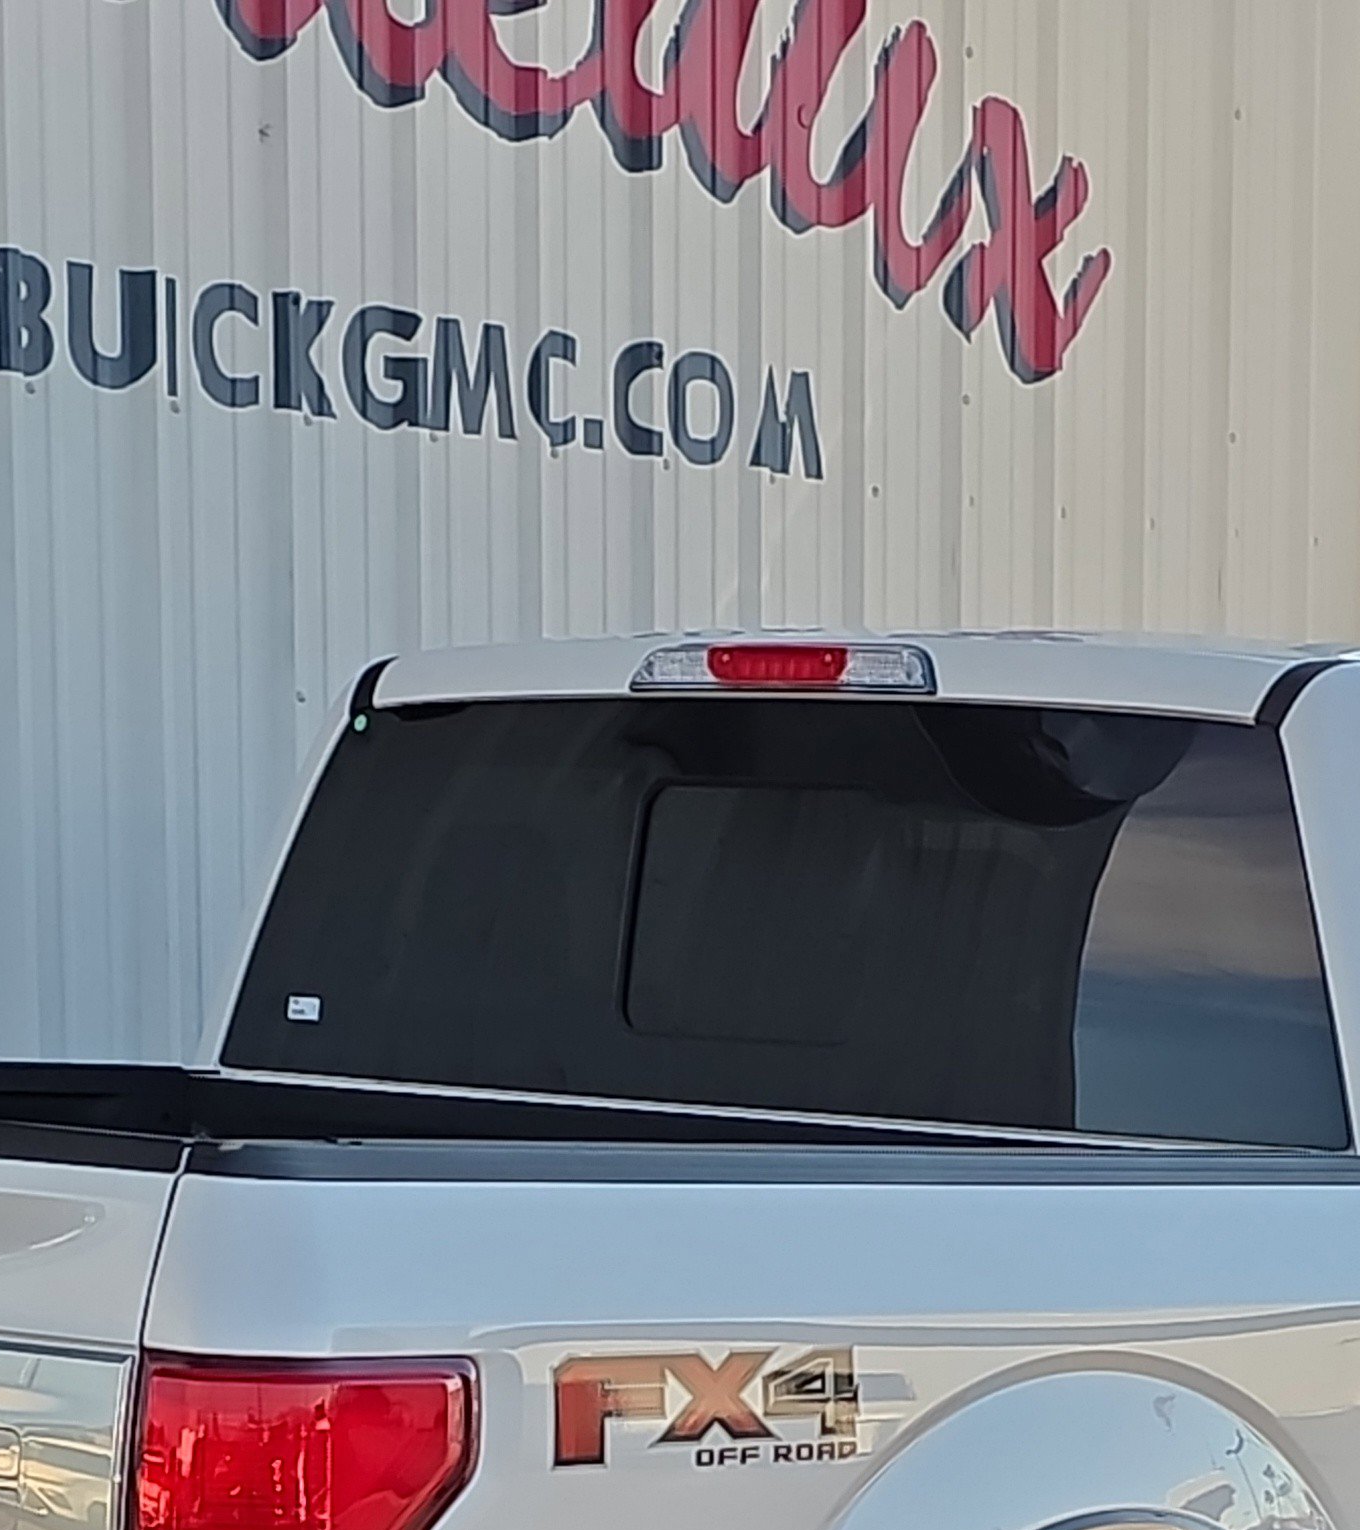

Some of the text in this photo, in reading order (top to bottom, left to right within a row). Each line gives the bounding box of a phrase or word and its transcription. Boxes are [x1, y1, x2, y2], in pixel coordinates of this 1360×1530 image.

[552, 1346, 860, 1467] FX4
[695, 1440, 857, 1468] OFF ROAD
